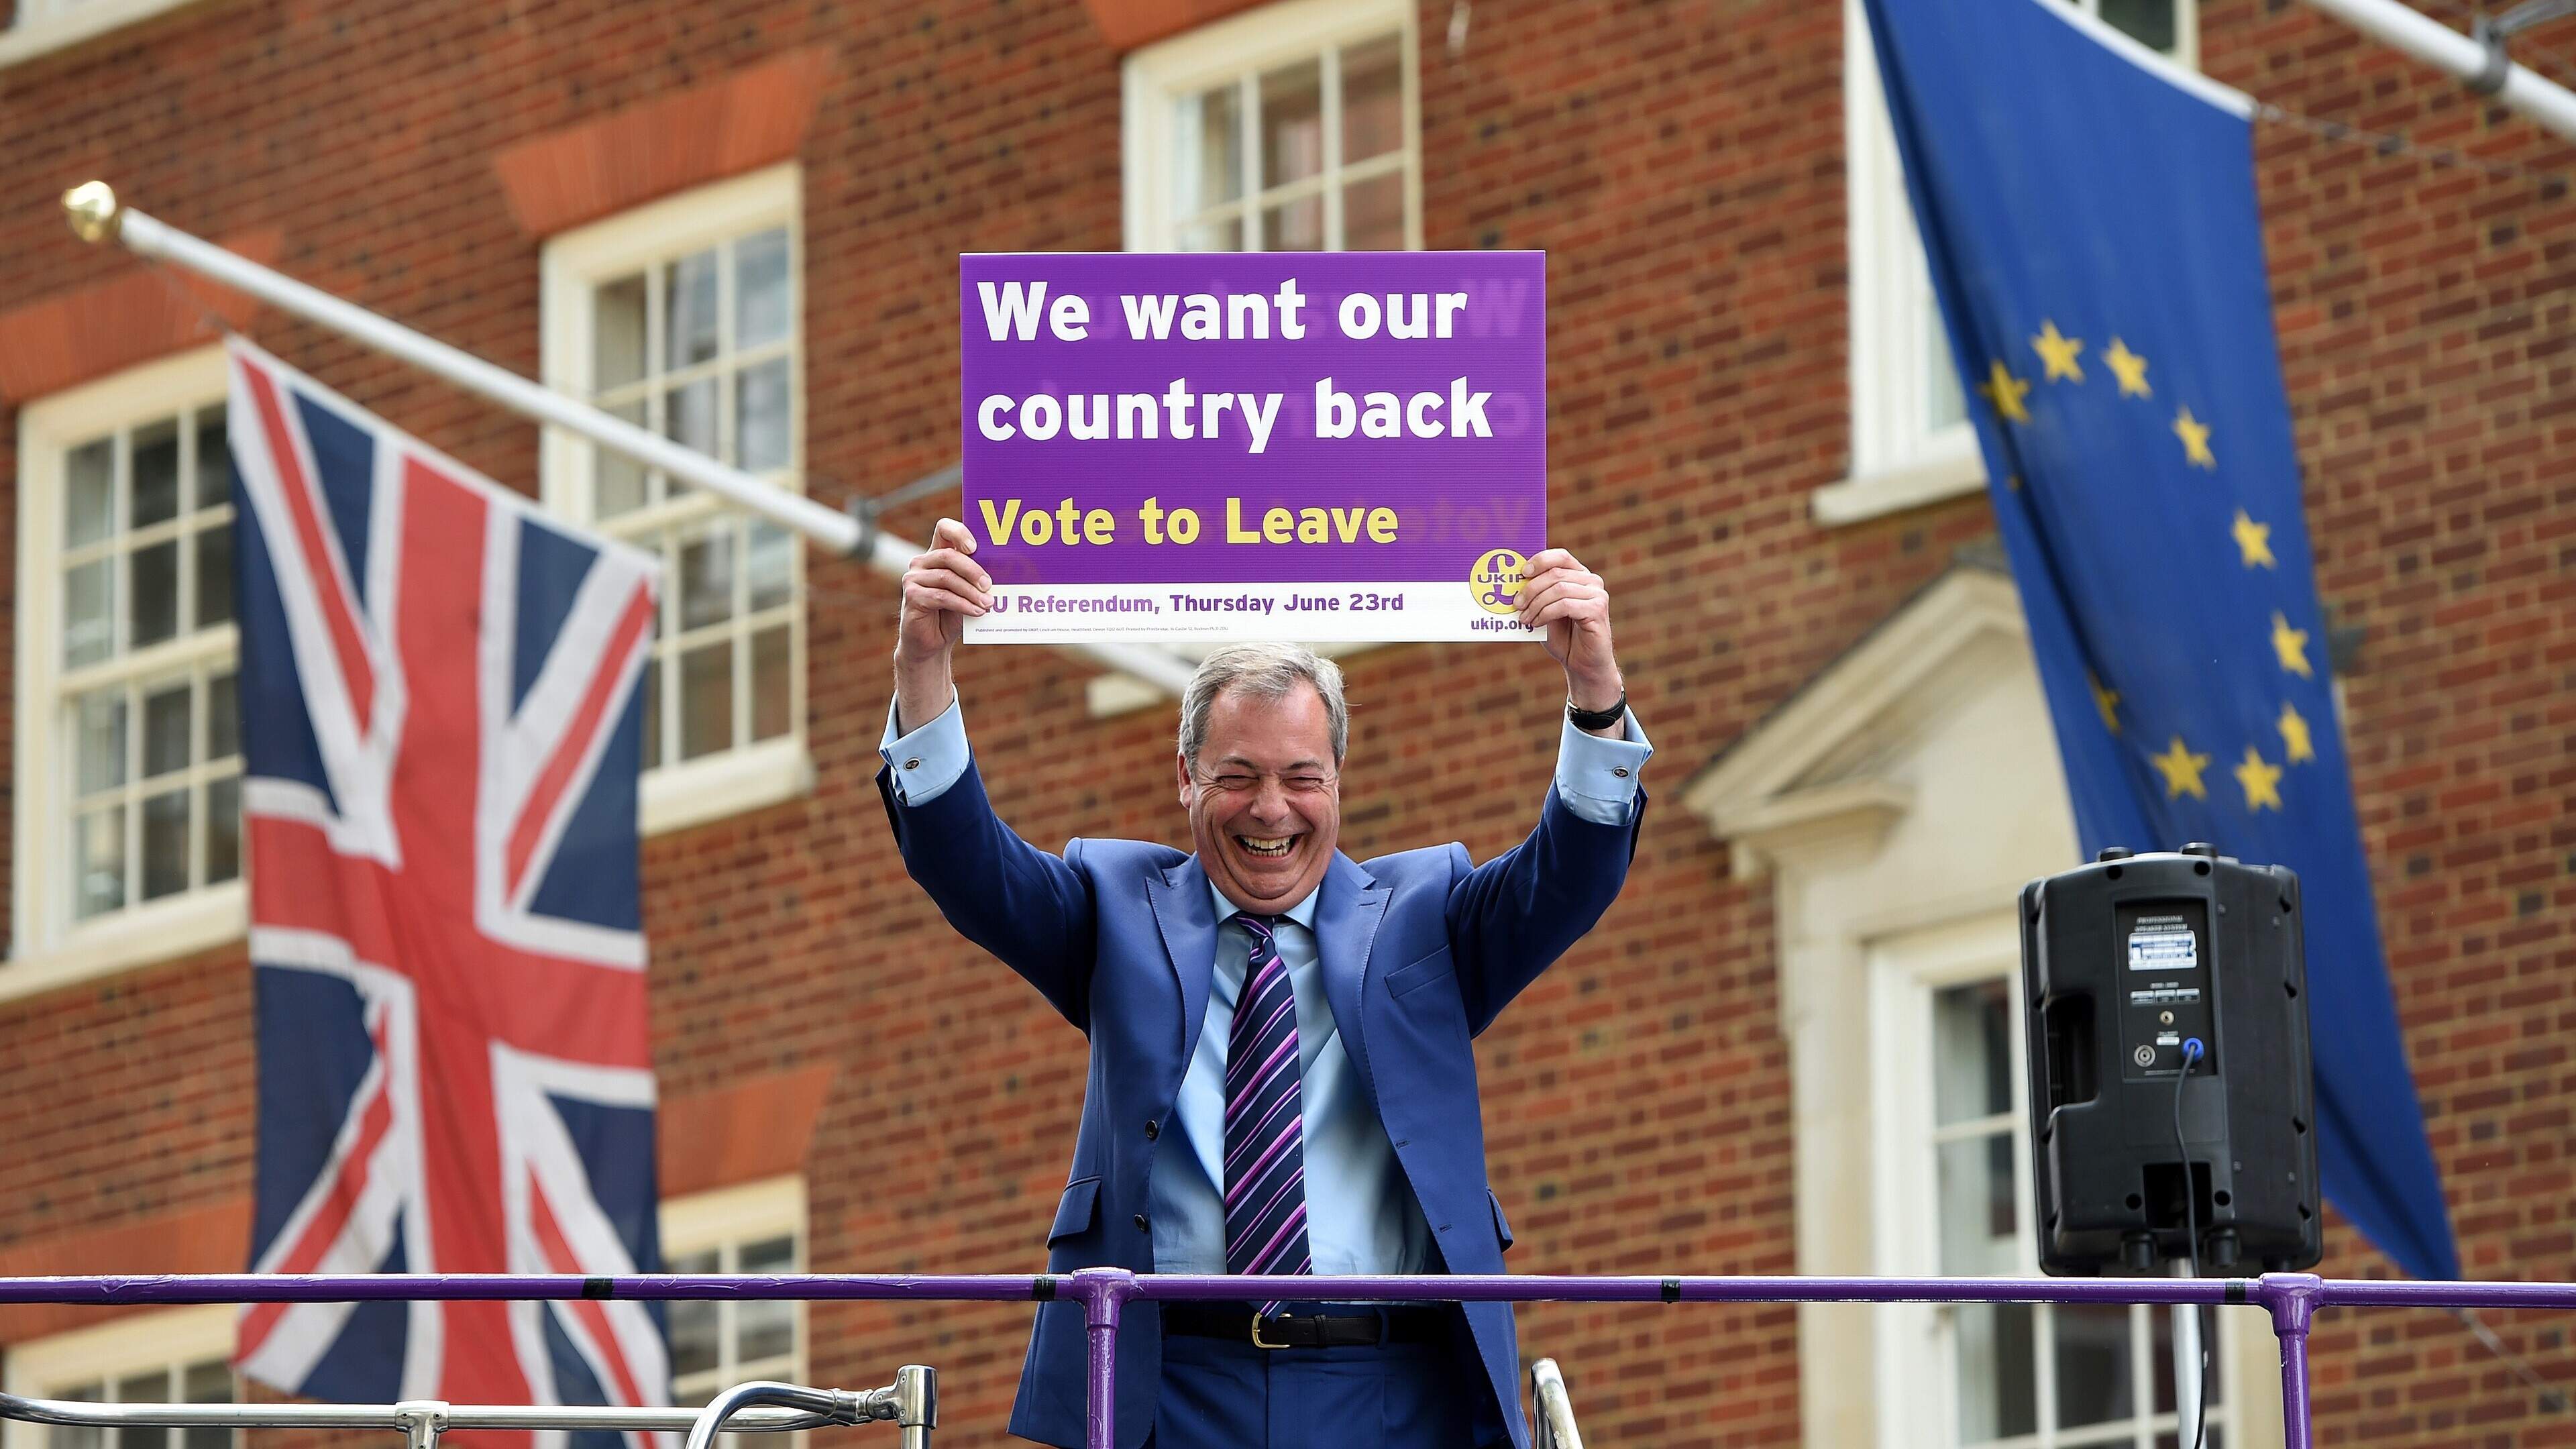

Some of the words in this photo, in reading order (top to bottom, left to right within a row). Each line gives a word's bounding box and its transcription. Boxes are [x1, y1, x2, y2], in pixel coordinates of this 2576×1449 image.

[977, 282, 1089, 341] We
[1120, 278, 1305, 340] want
[1339, 292, 1468, 339] our
[978, 378, 1283, 453] country
[1316, 376, 1493, 438] back
[979, 498, 1114, 545] Vote
[1139, 497, 1199, 544] to
[1227, 498, 1398, 544] Leave
[1477, 574, 1526, 583] UKIP
[985, 596, 1008, 613] U
[1018, 595, 1159, 614] Referendum,
[1170, 594, 1274, 615] Thursday
[1284, 594, 1339, 611] June
[1349, 593, 1403, 611] 23rd
